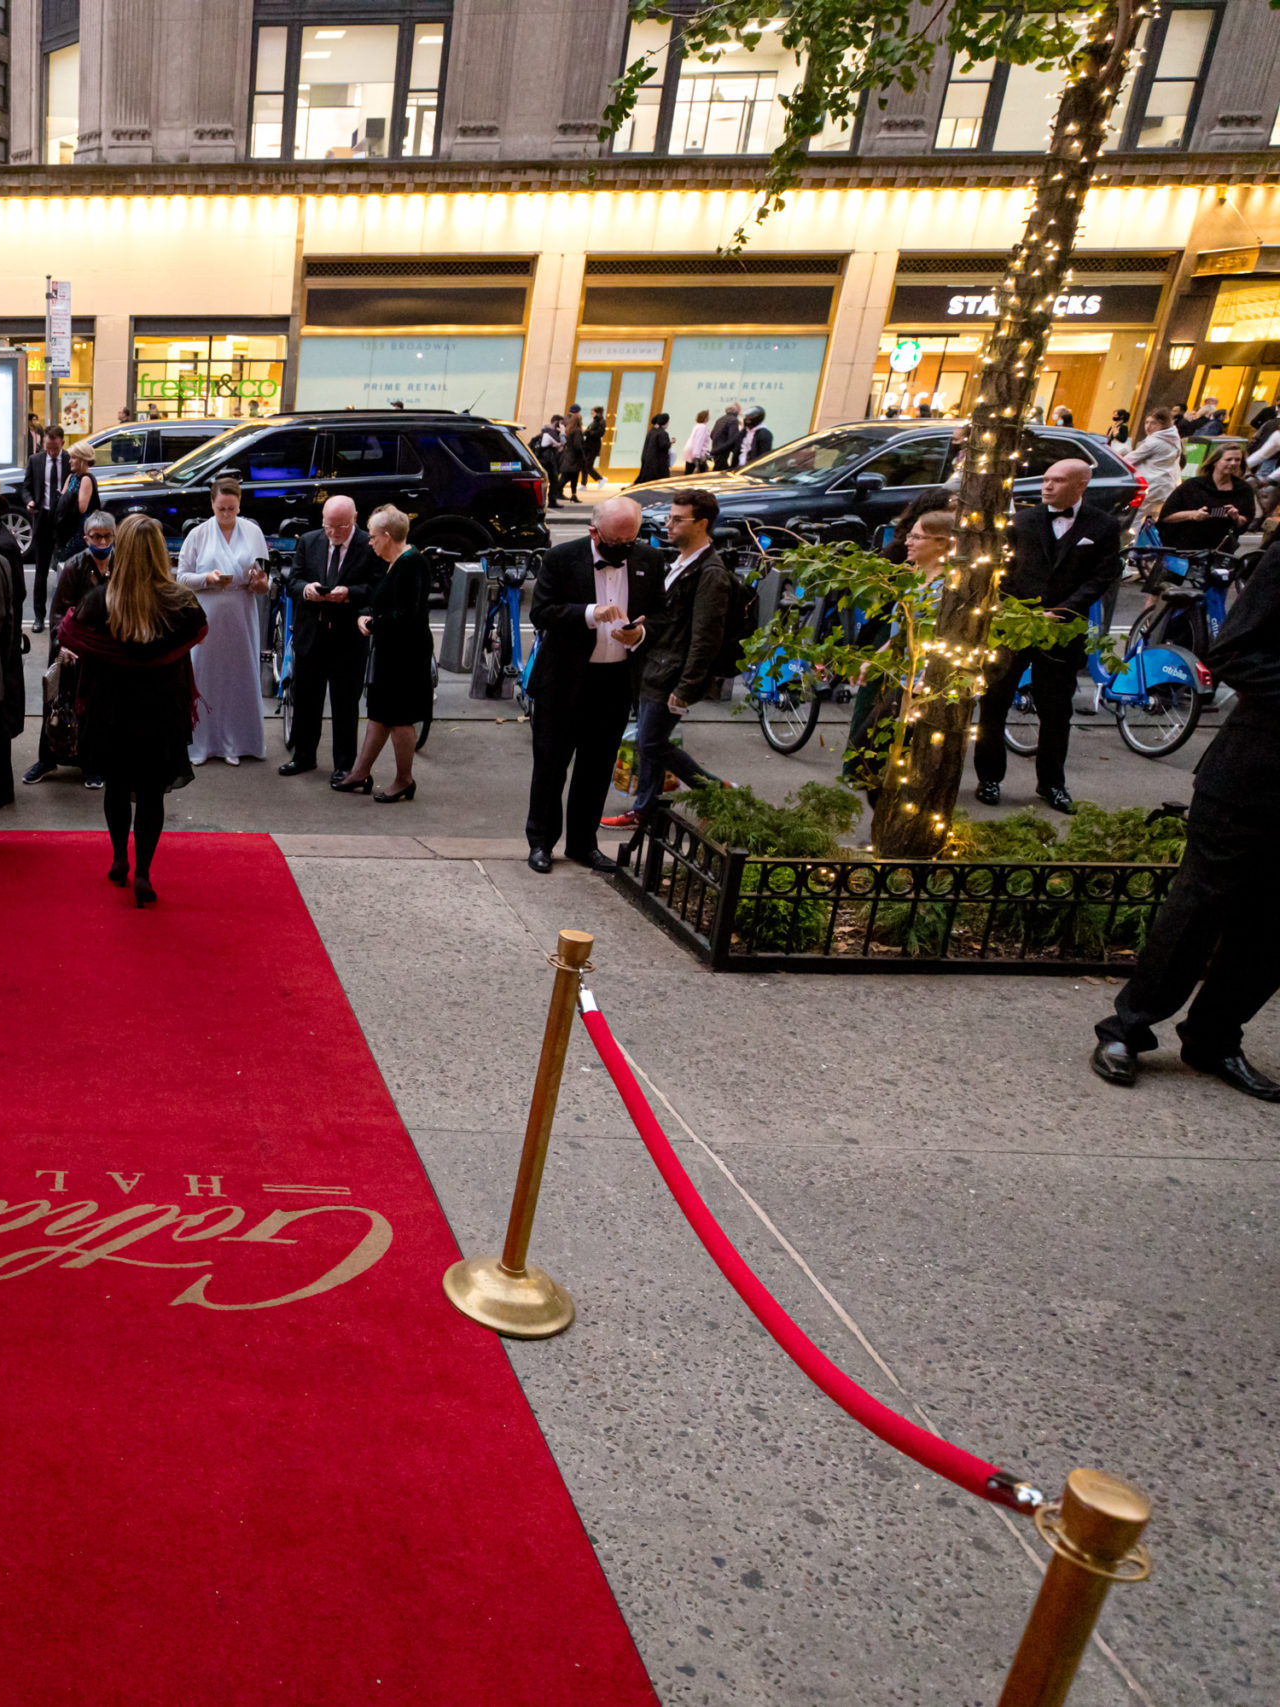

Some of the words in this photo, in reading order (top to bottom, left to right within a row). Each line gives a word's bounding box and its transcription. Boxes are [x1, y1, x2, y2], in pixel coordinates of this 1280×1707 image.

[947, 295, 1102, 316] STACKS
[391, 341, 457, 351] BROADWAY
[138, 373, 277, 399] fresh&co
[363, 383, 401, 391] PRIME
[407, 383, 448, 391] RETAIL
[697, 382, 736, 391] PRIME
[742, 382, 785, 391] RETAIL
